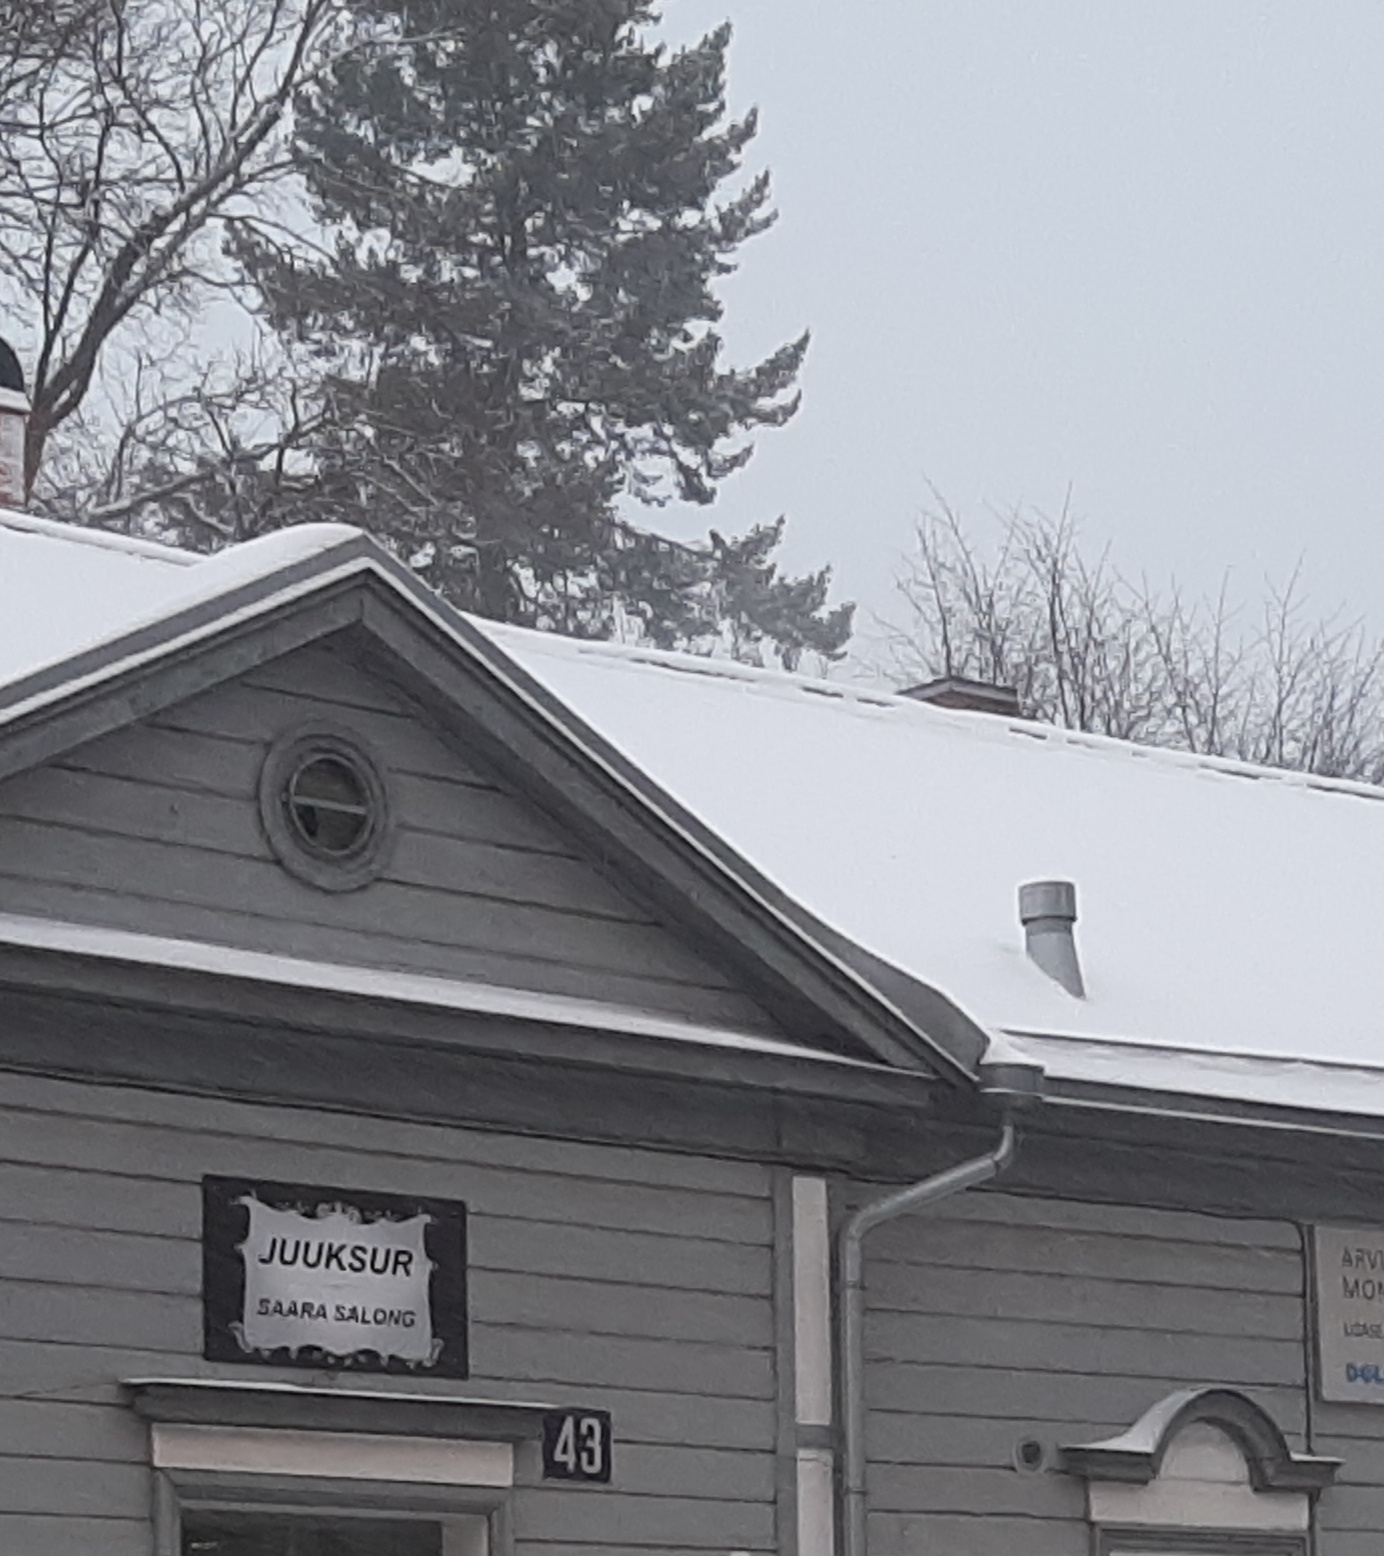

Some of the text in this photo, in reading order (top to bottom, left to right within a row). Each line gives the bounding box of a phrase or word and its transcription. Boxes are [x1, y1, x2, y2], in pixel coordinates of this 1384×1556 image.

[259, 1238, 414, 1277] JUUKSUR
[257, 1299, 416, 1328] SAARA SALONG
[555, 1416, 602, 1474] 43
